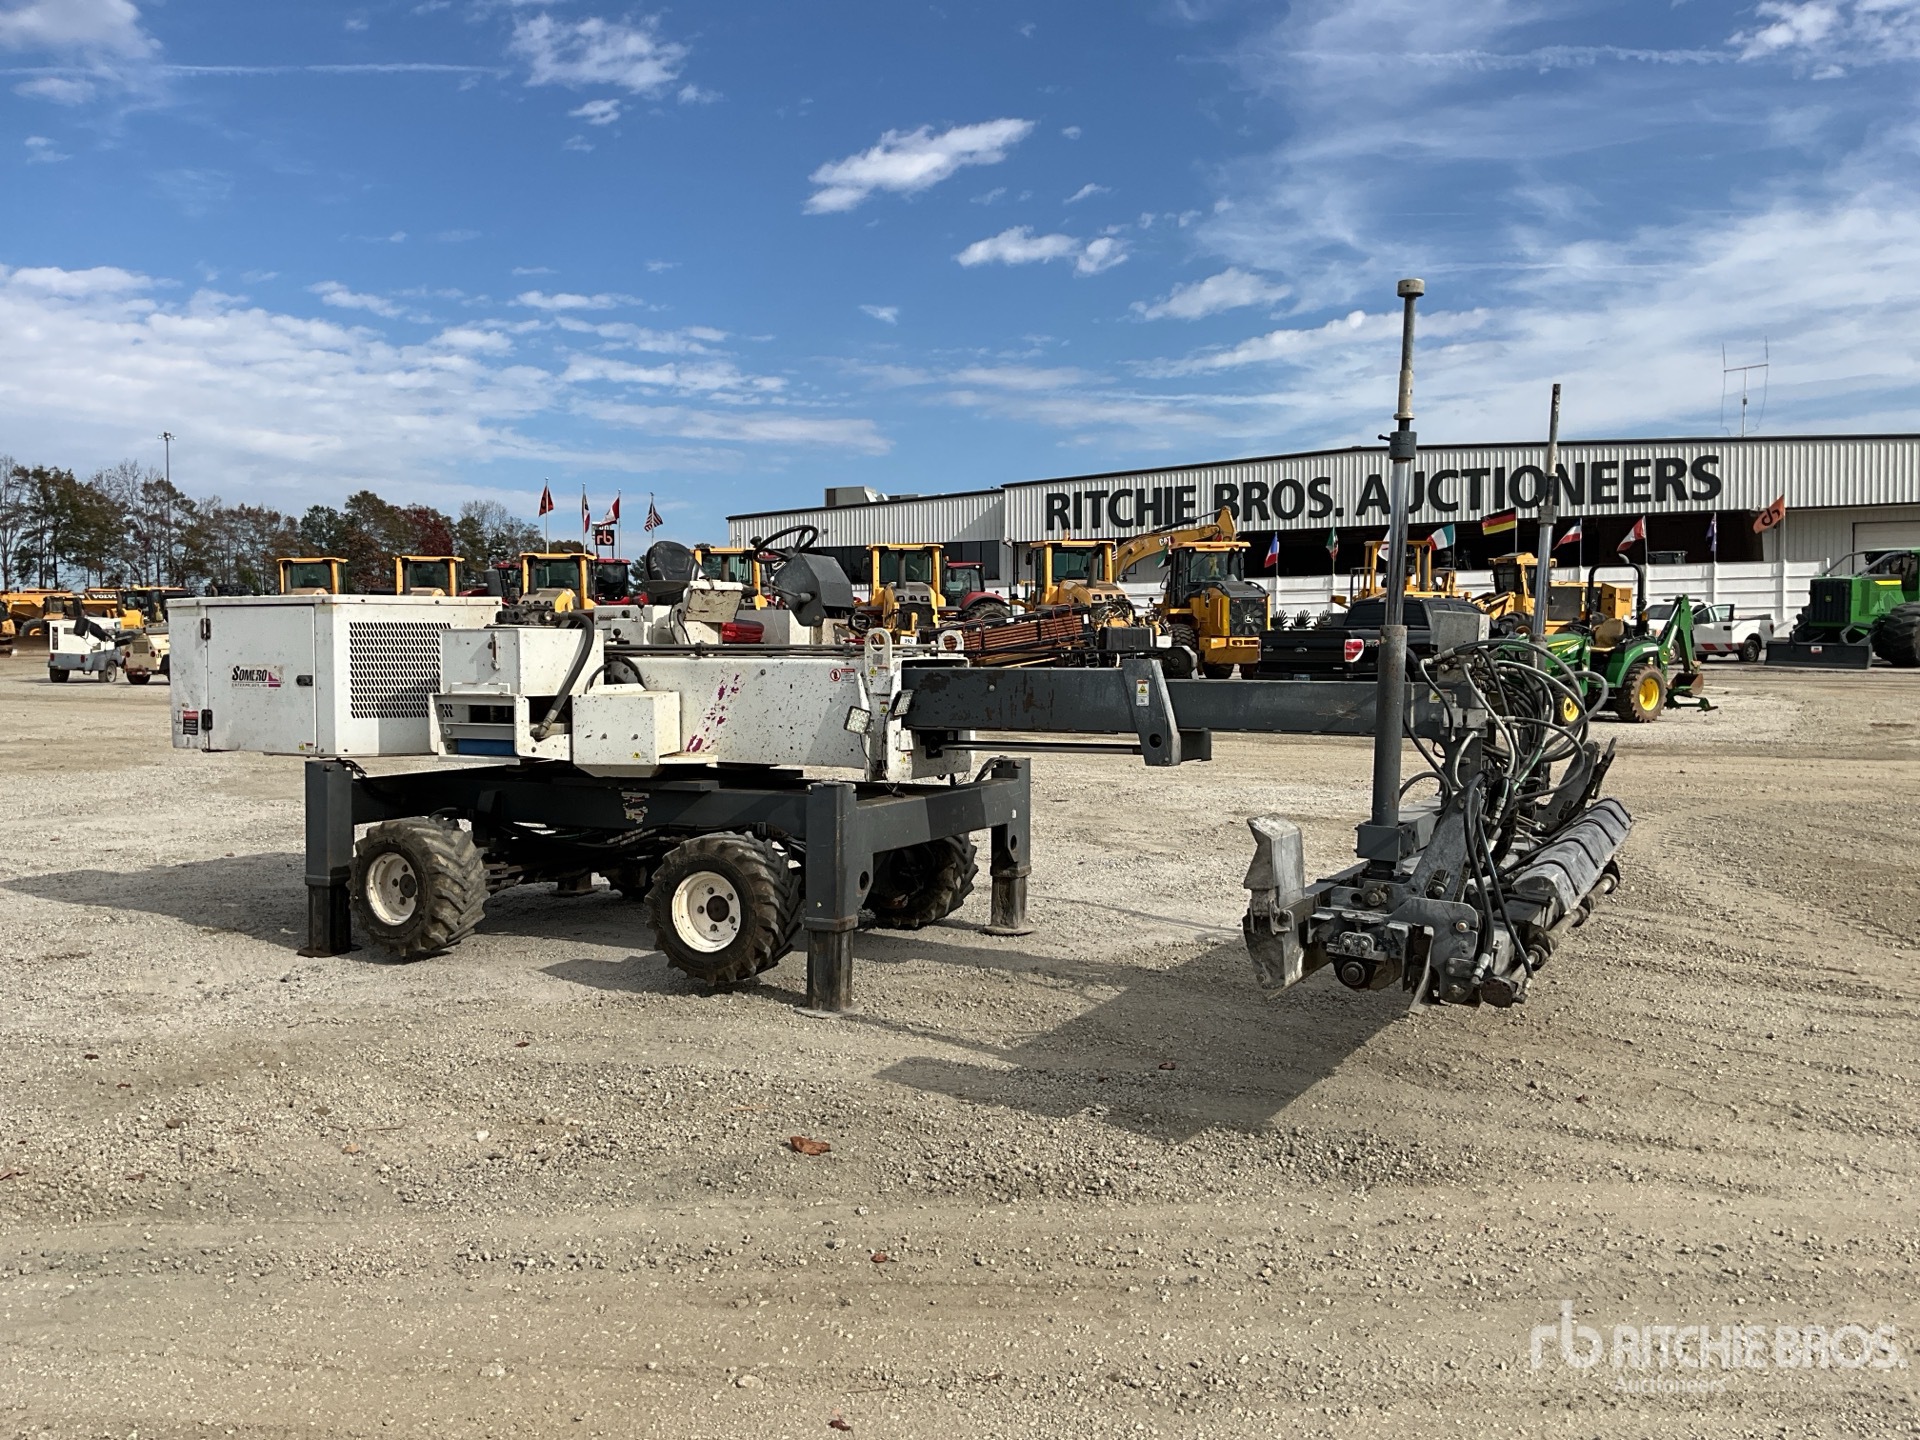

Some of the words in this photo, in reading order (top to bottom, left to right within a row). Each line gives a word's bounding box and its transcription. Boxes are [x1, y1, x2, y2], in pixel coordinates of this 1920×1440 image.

[1046, 485, 1197, 530] RITCHIE
[1213, 477, 1345, 522] BROS.
[232, 665, 267, 682] SOMERO
